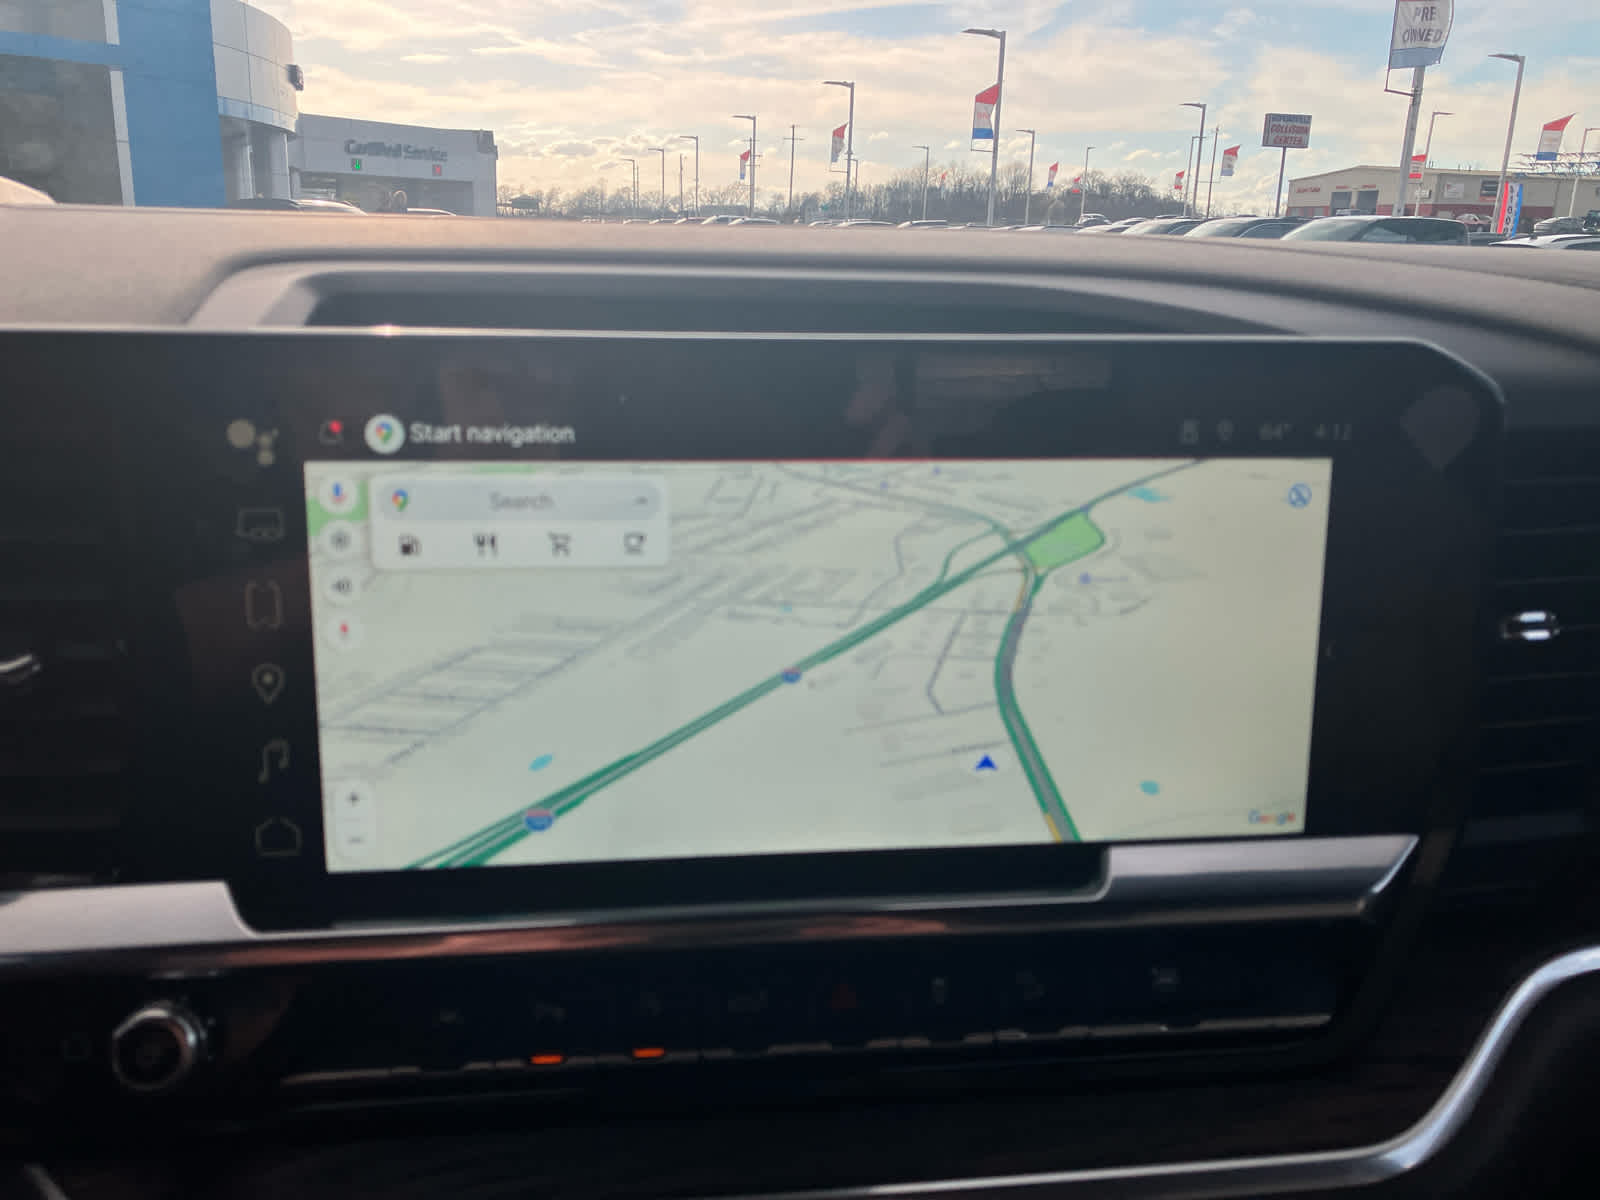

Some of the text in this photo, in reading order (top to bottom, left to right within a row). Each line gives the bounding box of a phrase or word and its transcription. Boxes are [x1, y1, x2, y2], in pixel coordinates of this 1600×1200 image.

[1414, 6, 1437, 21] PRE
[1402, 27, 1443, 43] OWNED
[409, 420, 577, 449] Start navigation
[489, 490, 555, 512] Search
